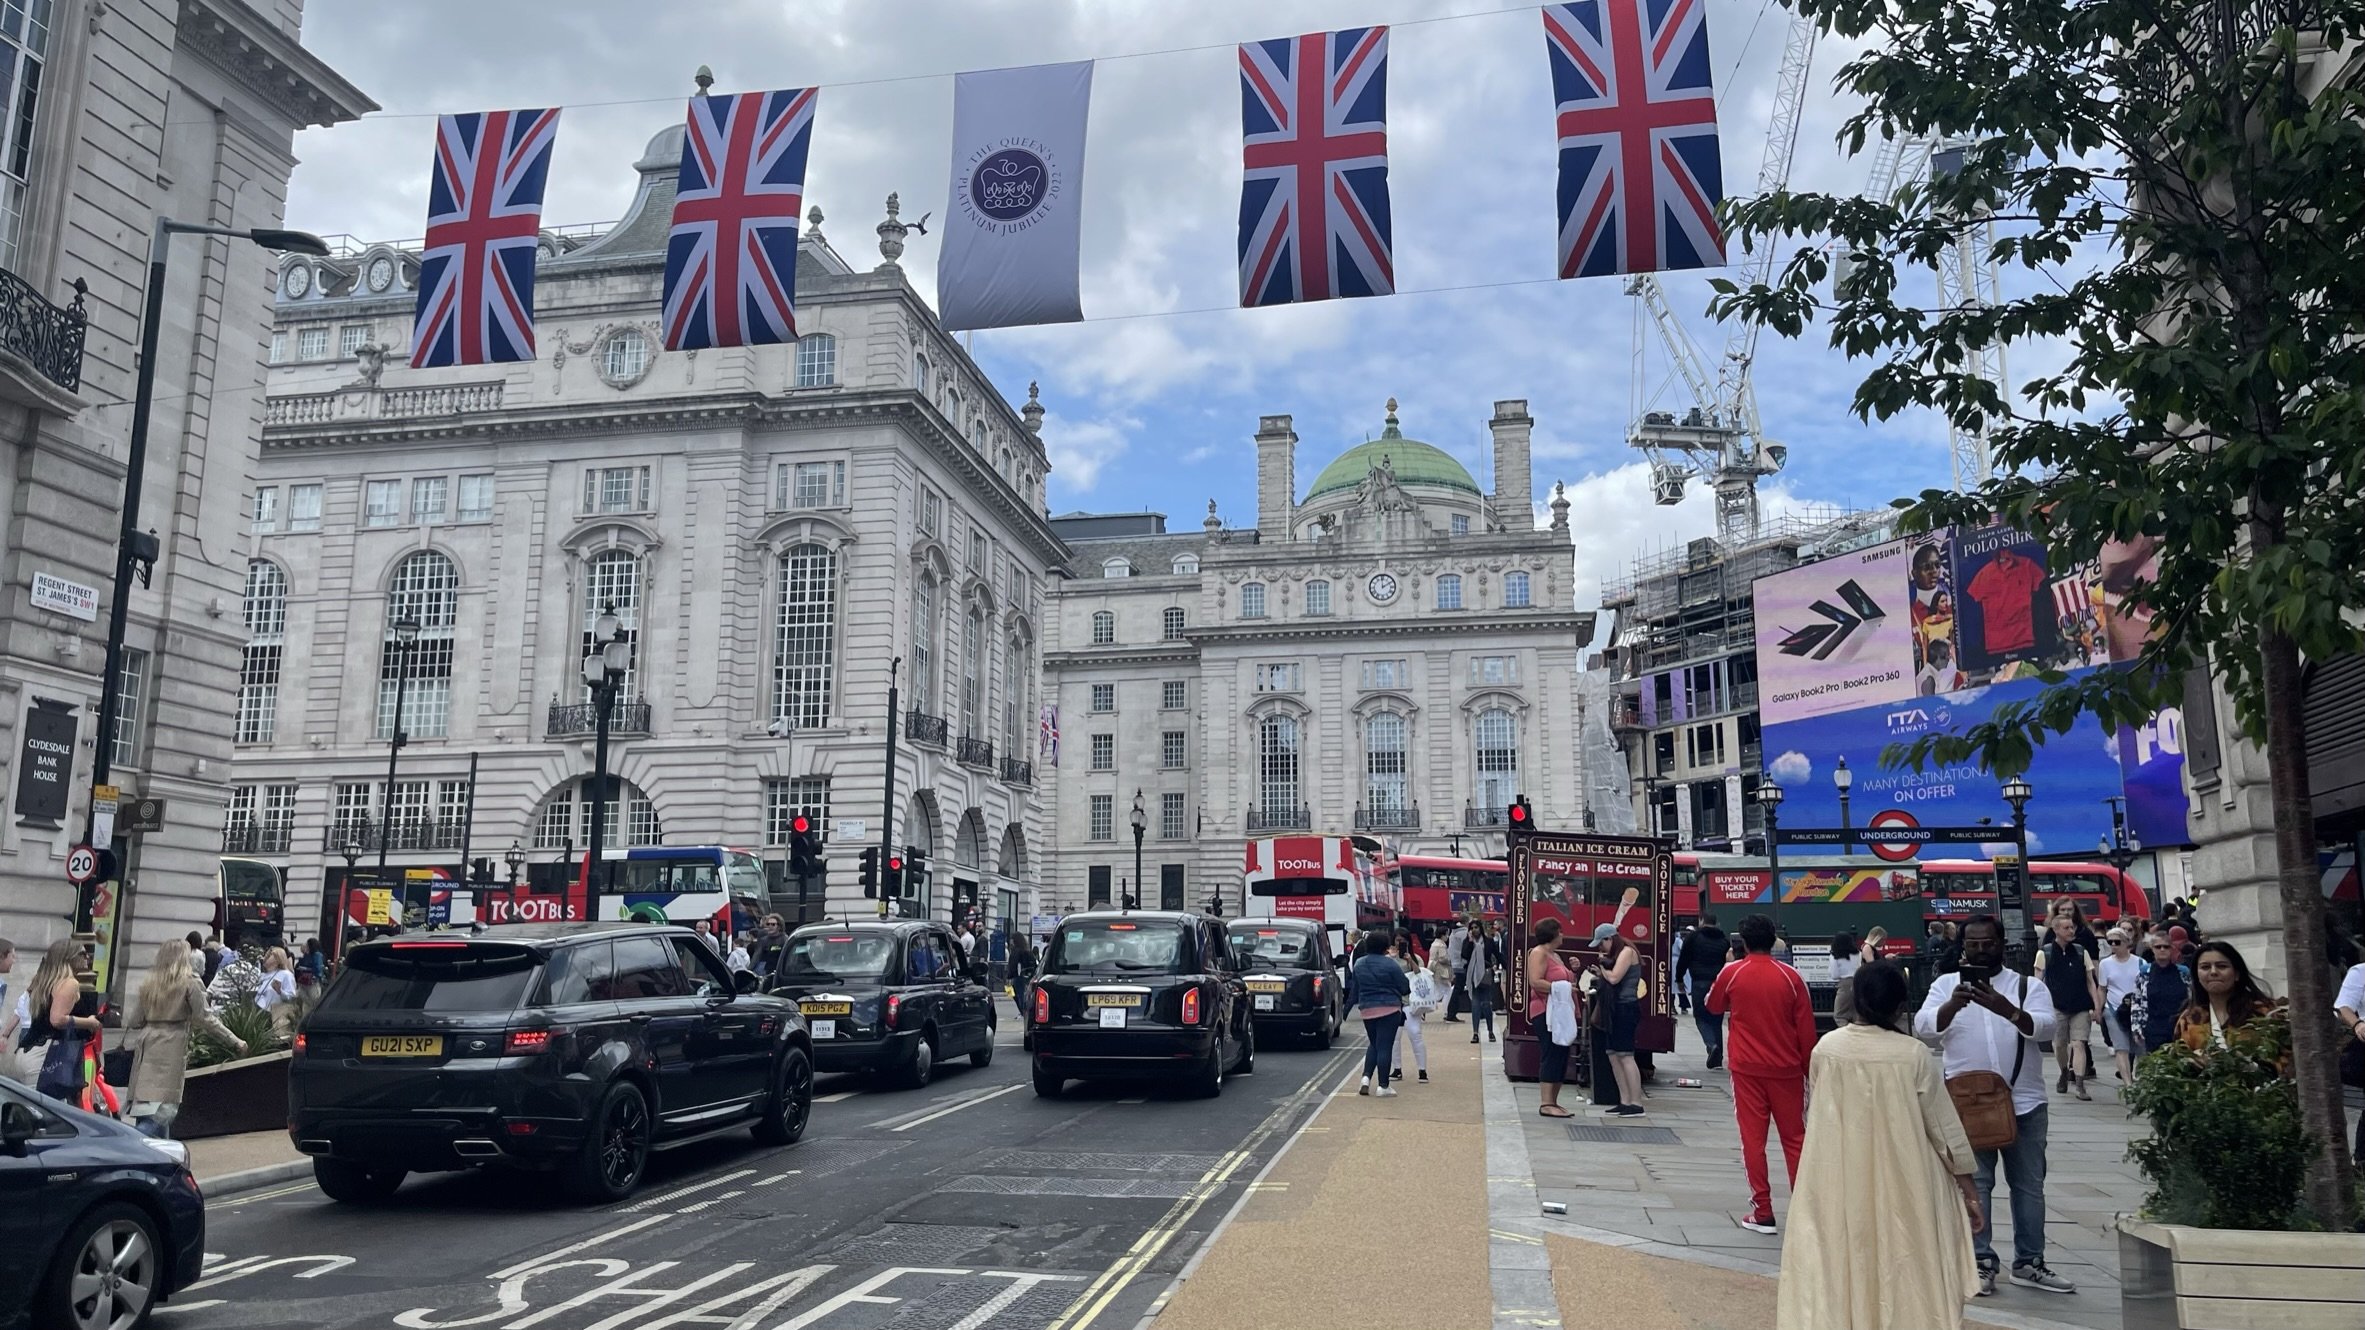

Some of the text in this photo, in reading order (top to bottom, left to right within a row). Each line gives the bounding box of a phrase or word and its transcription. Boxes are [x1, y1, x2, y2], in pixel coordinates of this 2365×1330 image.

[969, 136, 1055, 164] THE QUEEN'S
[957, 171, 1062, 237] PLATINUM JUBILEE 2022
[1963, 529, 2036, 558] POLO SHIR
[1861, 546, 1901, 564] SAMSUNG
[38, 576, 92, 599] REGENT STREET
[48, 590, 78, 606] JAMES'S
[79, 598, 94, 610] SW1
[1772, 670, 1900, 703] Galaxy Book2 Pro Book2 Pro 360
[1887, 708, 1930, 728] ITA
[1891, 722, 1928, 735] AIRWAYS
[28, 738, 70, 755] CLYDESDALE
[37, 755, 57, 767] BANK
[33, 769, 57, 782] HOUSE
[1862, 776, 1899, 792] MANY
[1894, 784, 1956, 802] ON OFFER
[1860, 831, 1931, 840] UNDERGROUND
[1536, 840, 1649, 857] ITALIAN ICE CREAM
[71, 857, 92, 871] 20
[1538, 859, 1651, 876] Fancy an Ice Cream
[1715, 876, 1734, 884] BUY
[1725, 891, 1750, 899] HERE
[1930, 899, 1988, 908] SNAMUSK
[1514, 853, 1526, 1004] FLAVOURED ICE CREAM
[1657, 860, 1668, 1015] SOFT ICE CREAM
[806, 1003, 845, 1013] KD15 PGZ
[1092, 995, 1137, 1004] LP69 KFR
[371, 1037, 434, 1052] GU21 SXP
